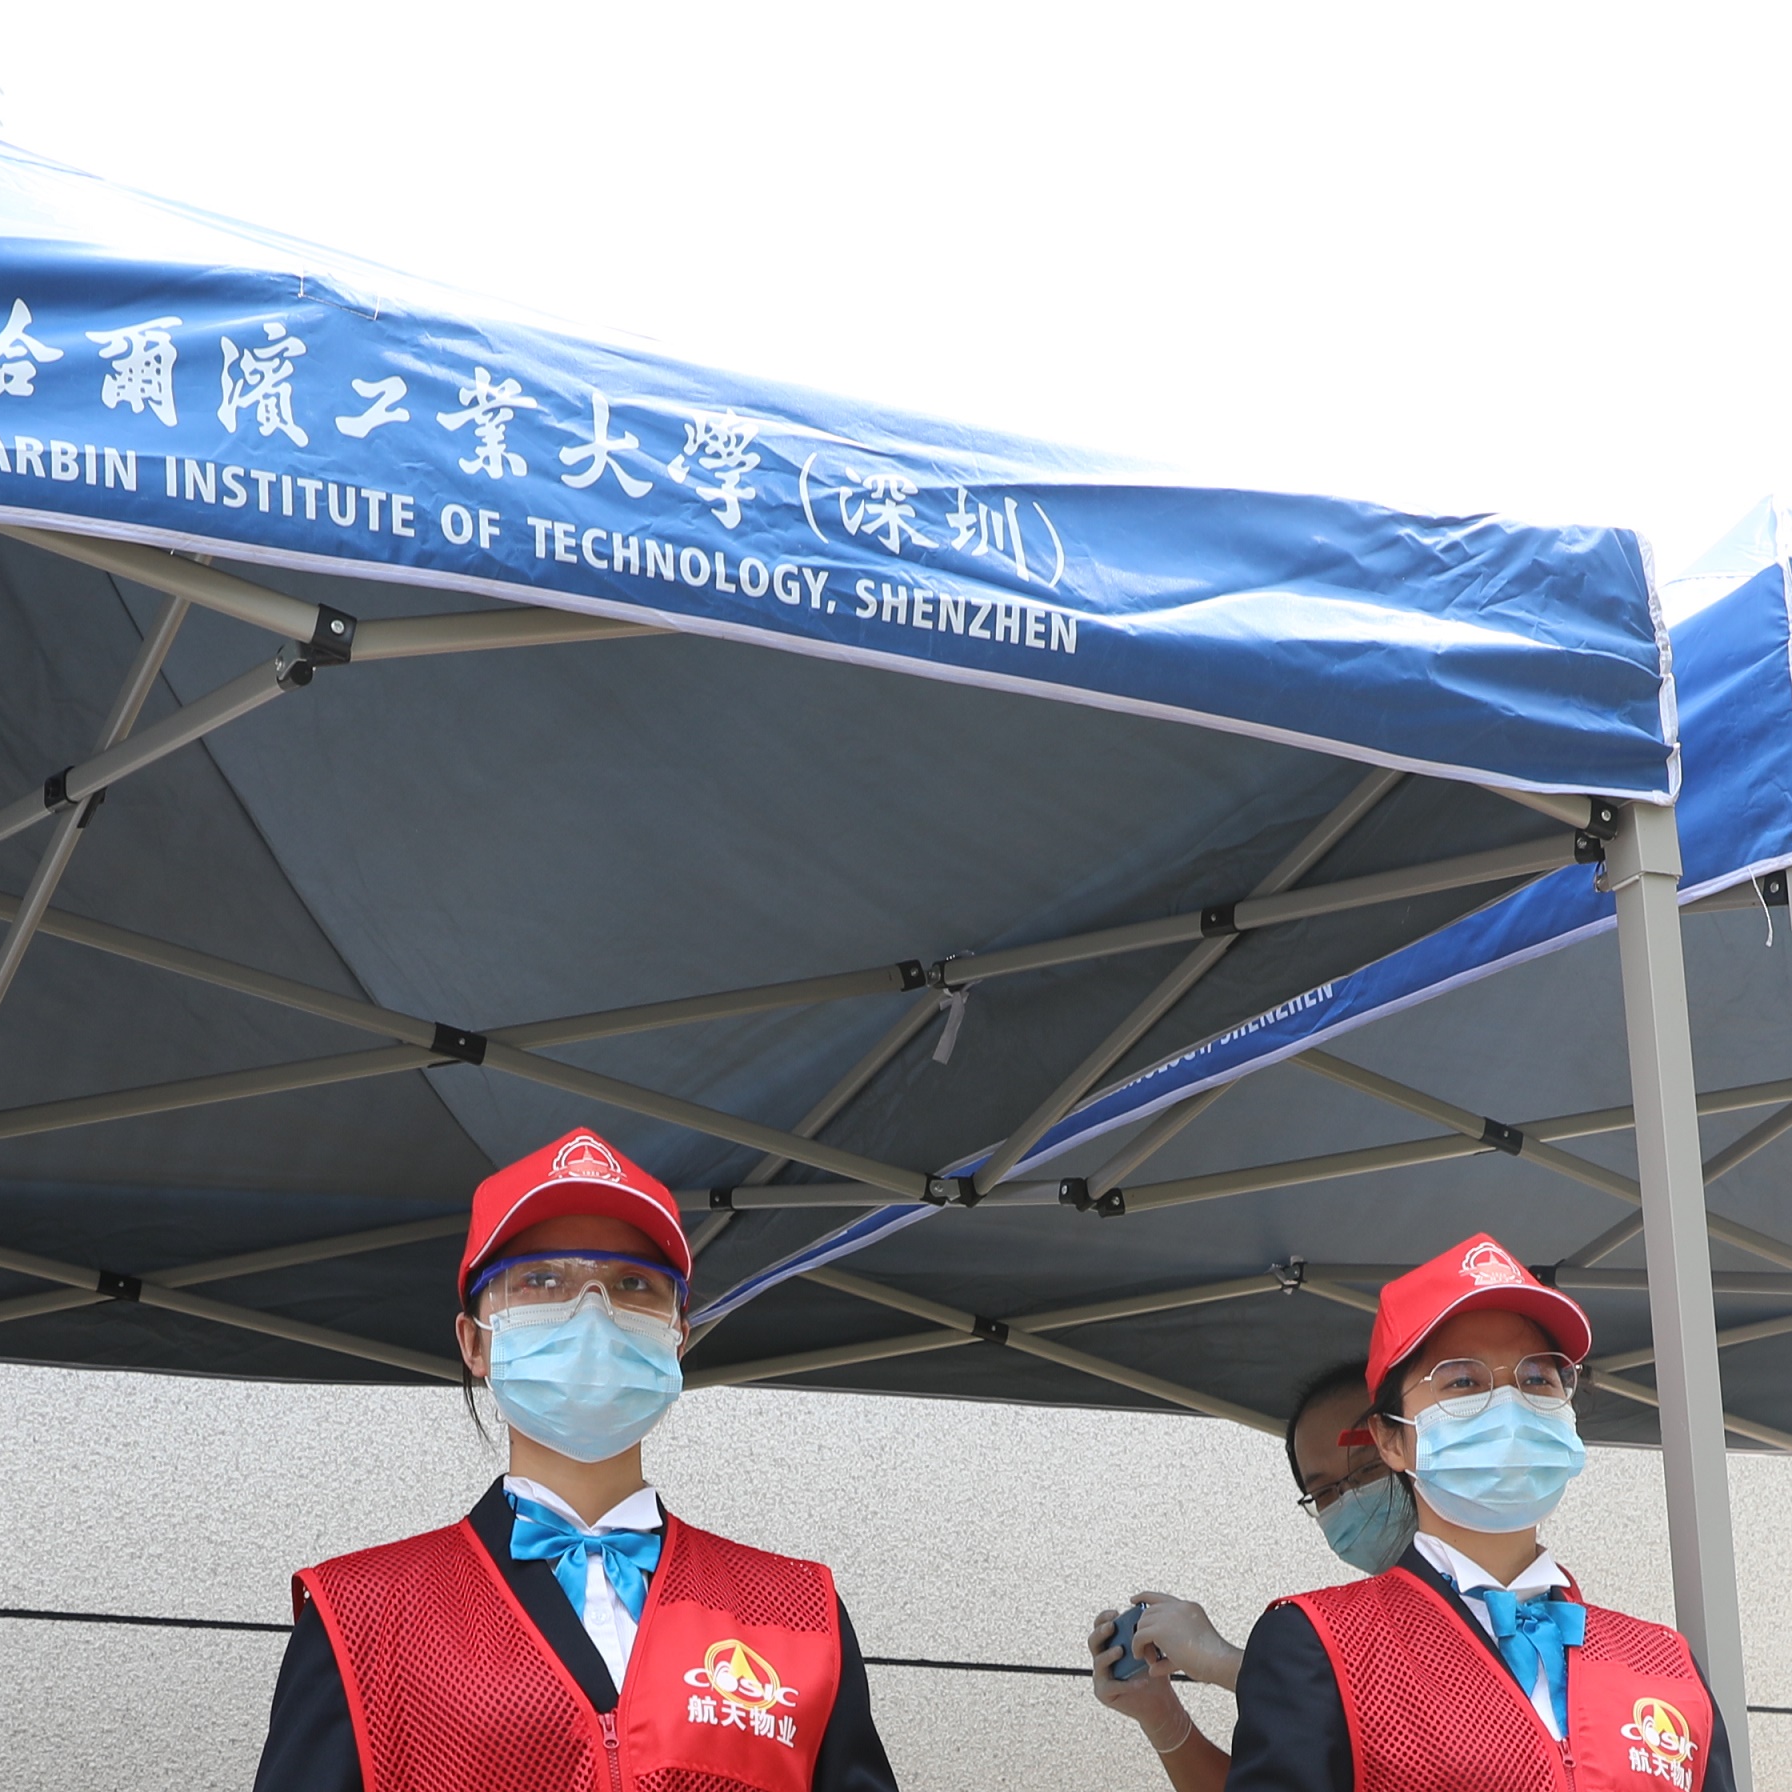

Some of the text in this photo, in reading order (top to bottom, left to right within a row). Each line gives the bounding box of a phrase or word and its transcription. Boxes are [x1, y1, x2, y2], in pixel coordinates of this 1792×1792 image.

[166, 456, 415, 539] INSTITUTE
[441, 502, 502, 550] OF
[527, 517, 836, 615] TECHNOLOGY,
[855, 580, 1079, 655] SHENZHEN
[687, 1694, 797, 1748] 航天物业
